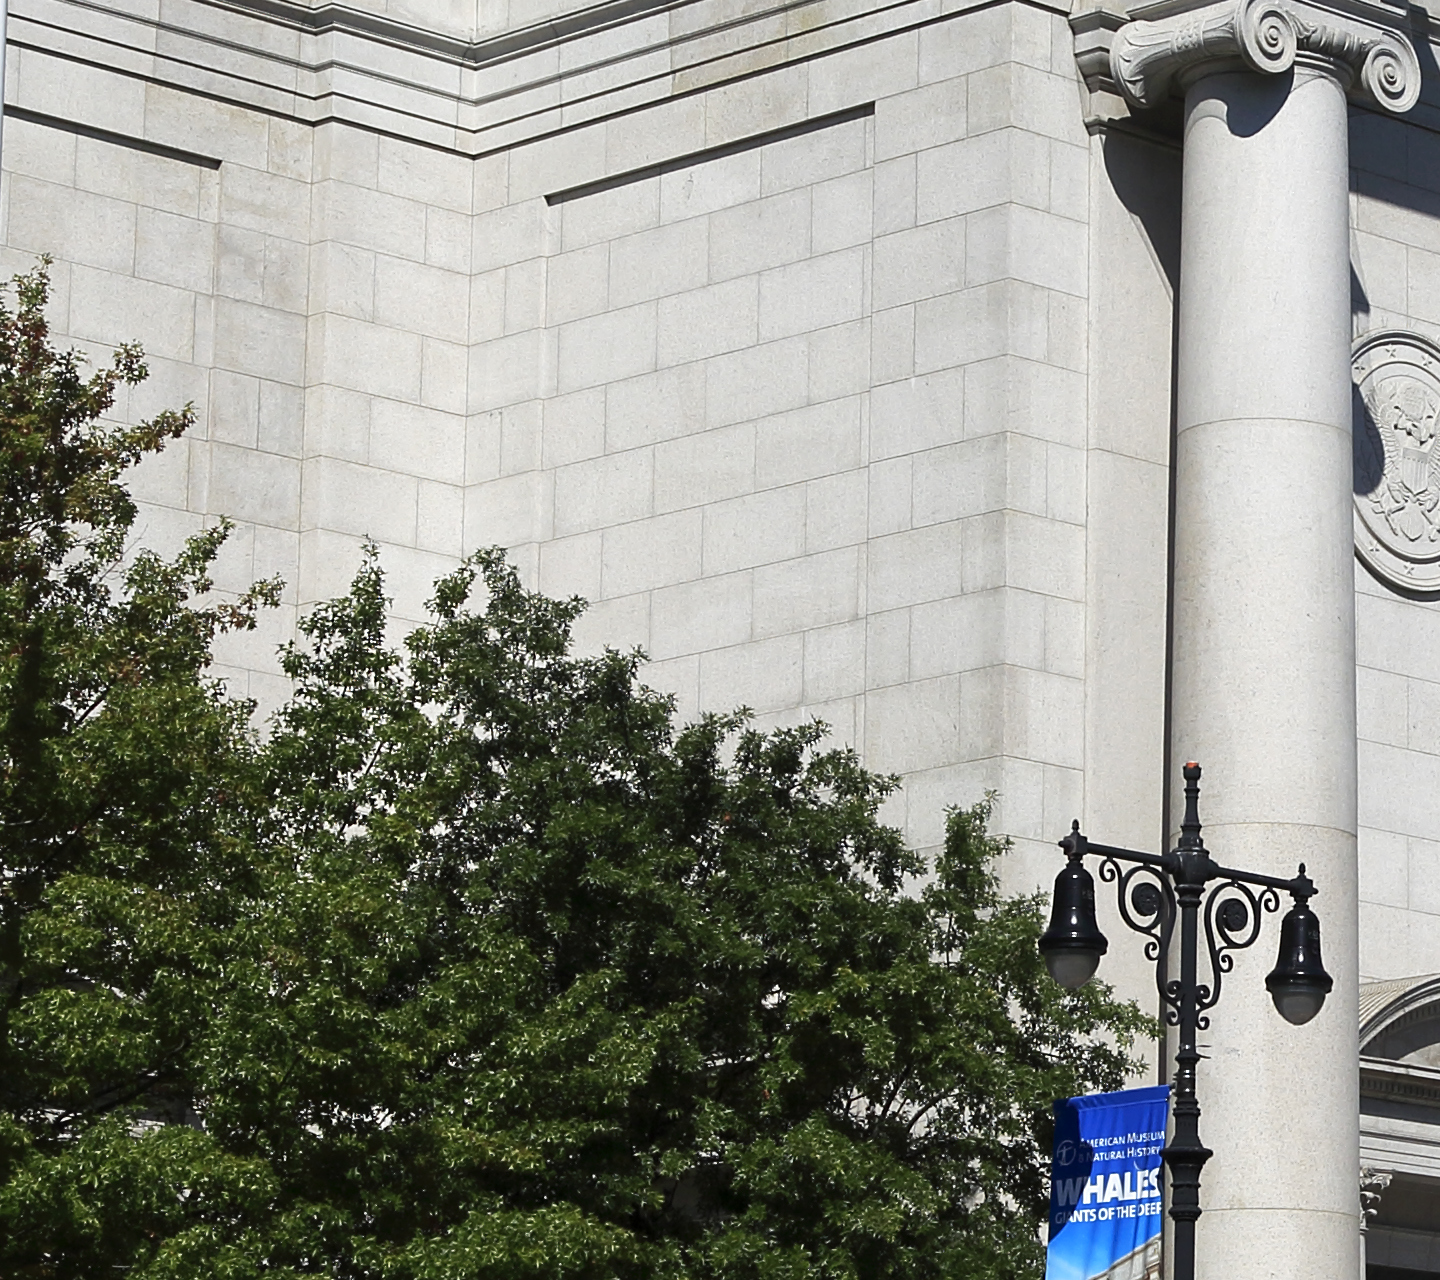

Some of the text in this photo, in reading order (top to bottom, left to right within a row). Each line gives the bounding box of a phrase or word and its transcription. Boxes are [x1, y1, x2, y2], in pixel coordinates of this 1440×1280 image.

[1079, 1130, 1165, 1149] AMERICAN MUSEUM
[1086, 1150, 1126, 1163] NATURAL
[1127, 1146, 1161, 1158] HISTORY
[1056, 1167, 1161, 1207] WHALES
[1055, 1208, 1097, 1224] GIANTS
[1098, 1206, 1115, 1221] OF
[1117, 1204, 1136, 1218] THE
